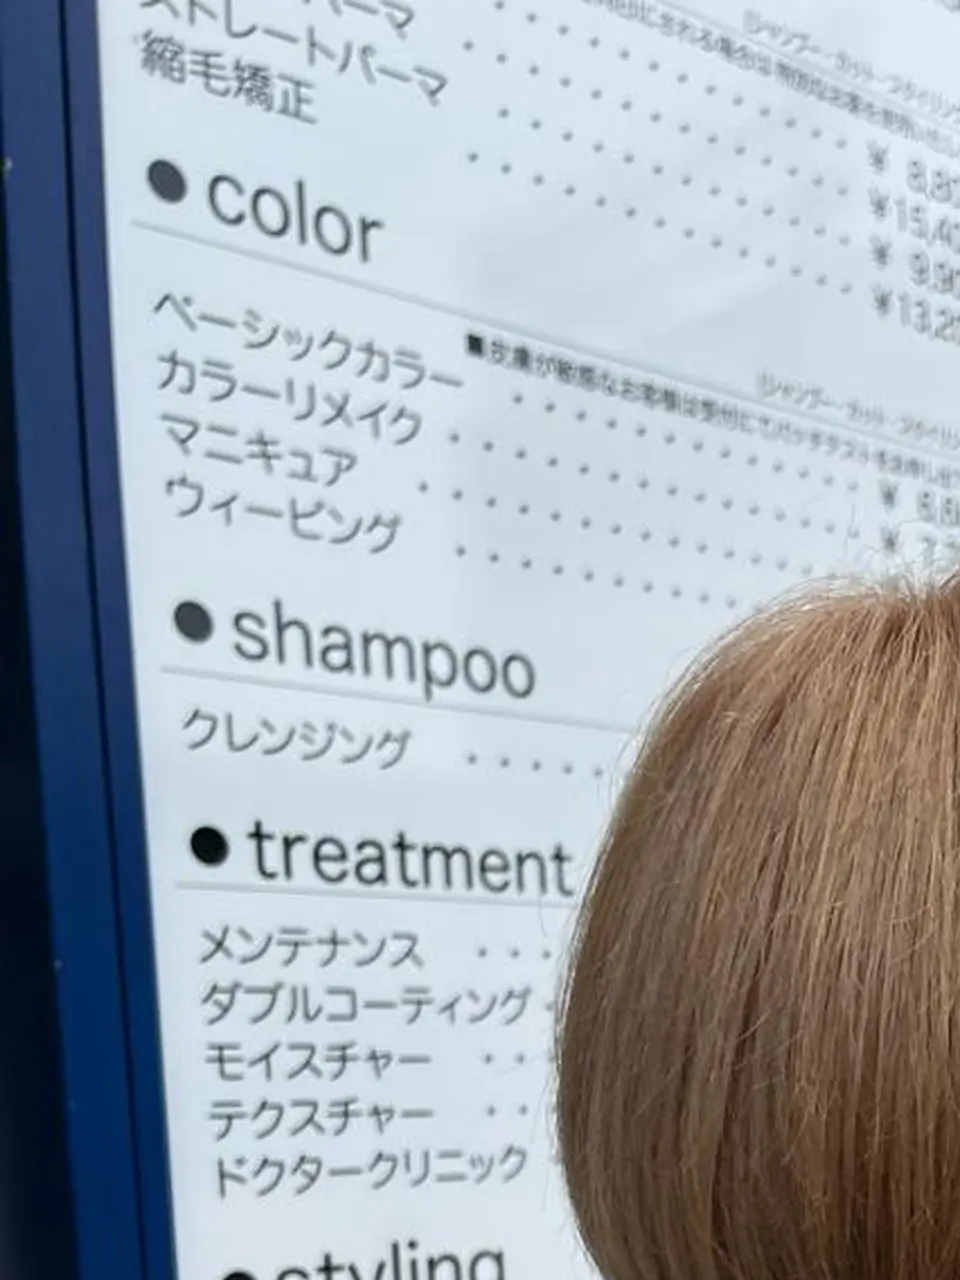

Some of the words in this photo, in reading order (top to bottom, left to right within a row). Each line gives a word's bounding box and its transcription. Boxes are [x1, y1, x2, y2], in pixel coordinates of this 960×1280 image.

[141, 28, 318, 125] 縮毛矯正
[207, 173, 384, 263] color
[154, 293, 464, 390] ベーシックカラー
[157, 350, 423, 446] カラーリメイク
[160, 412, 359, 486] マニキュア
[165, 472, 403, 555] ウィービング
[232, 598, 536, 703] shampoo
[181, 708, 412, 771] クレンジング
[246, 819, 576, 898] treatment
[199, 924, 425, 968] メンテナンス
[201, 981, 533, 1027] ダブルコーティング
[204, 1042, 432, 1083] モイスチャー
[207, 1097, 435, 1142] テクスチャー
[215, 1145, 529, 1199] ドクタークリニック
